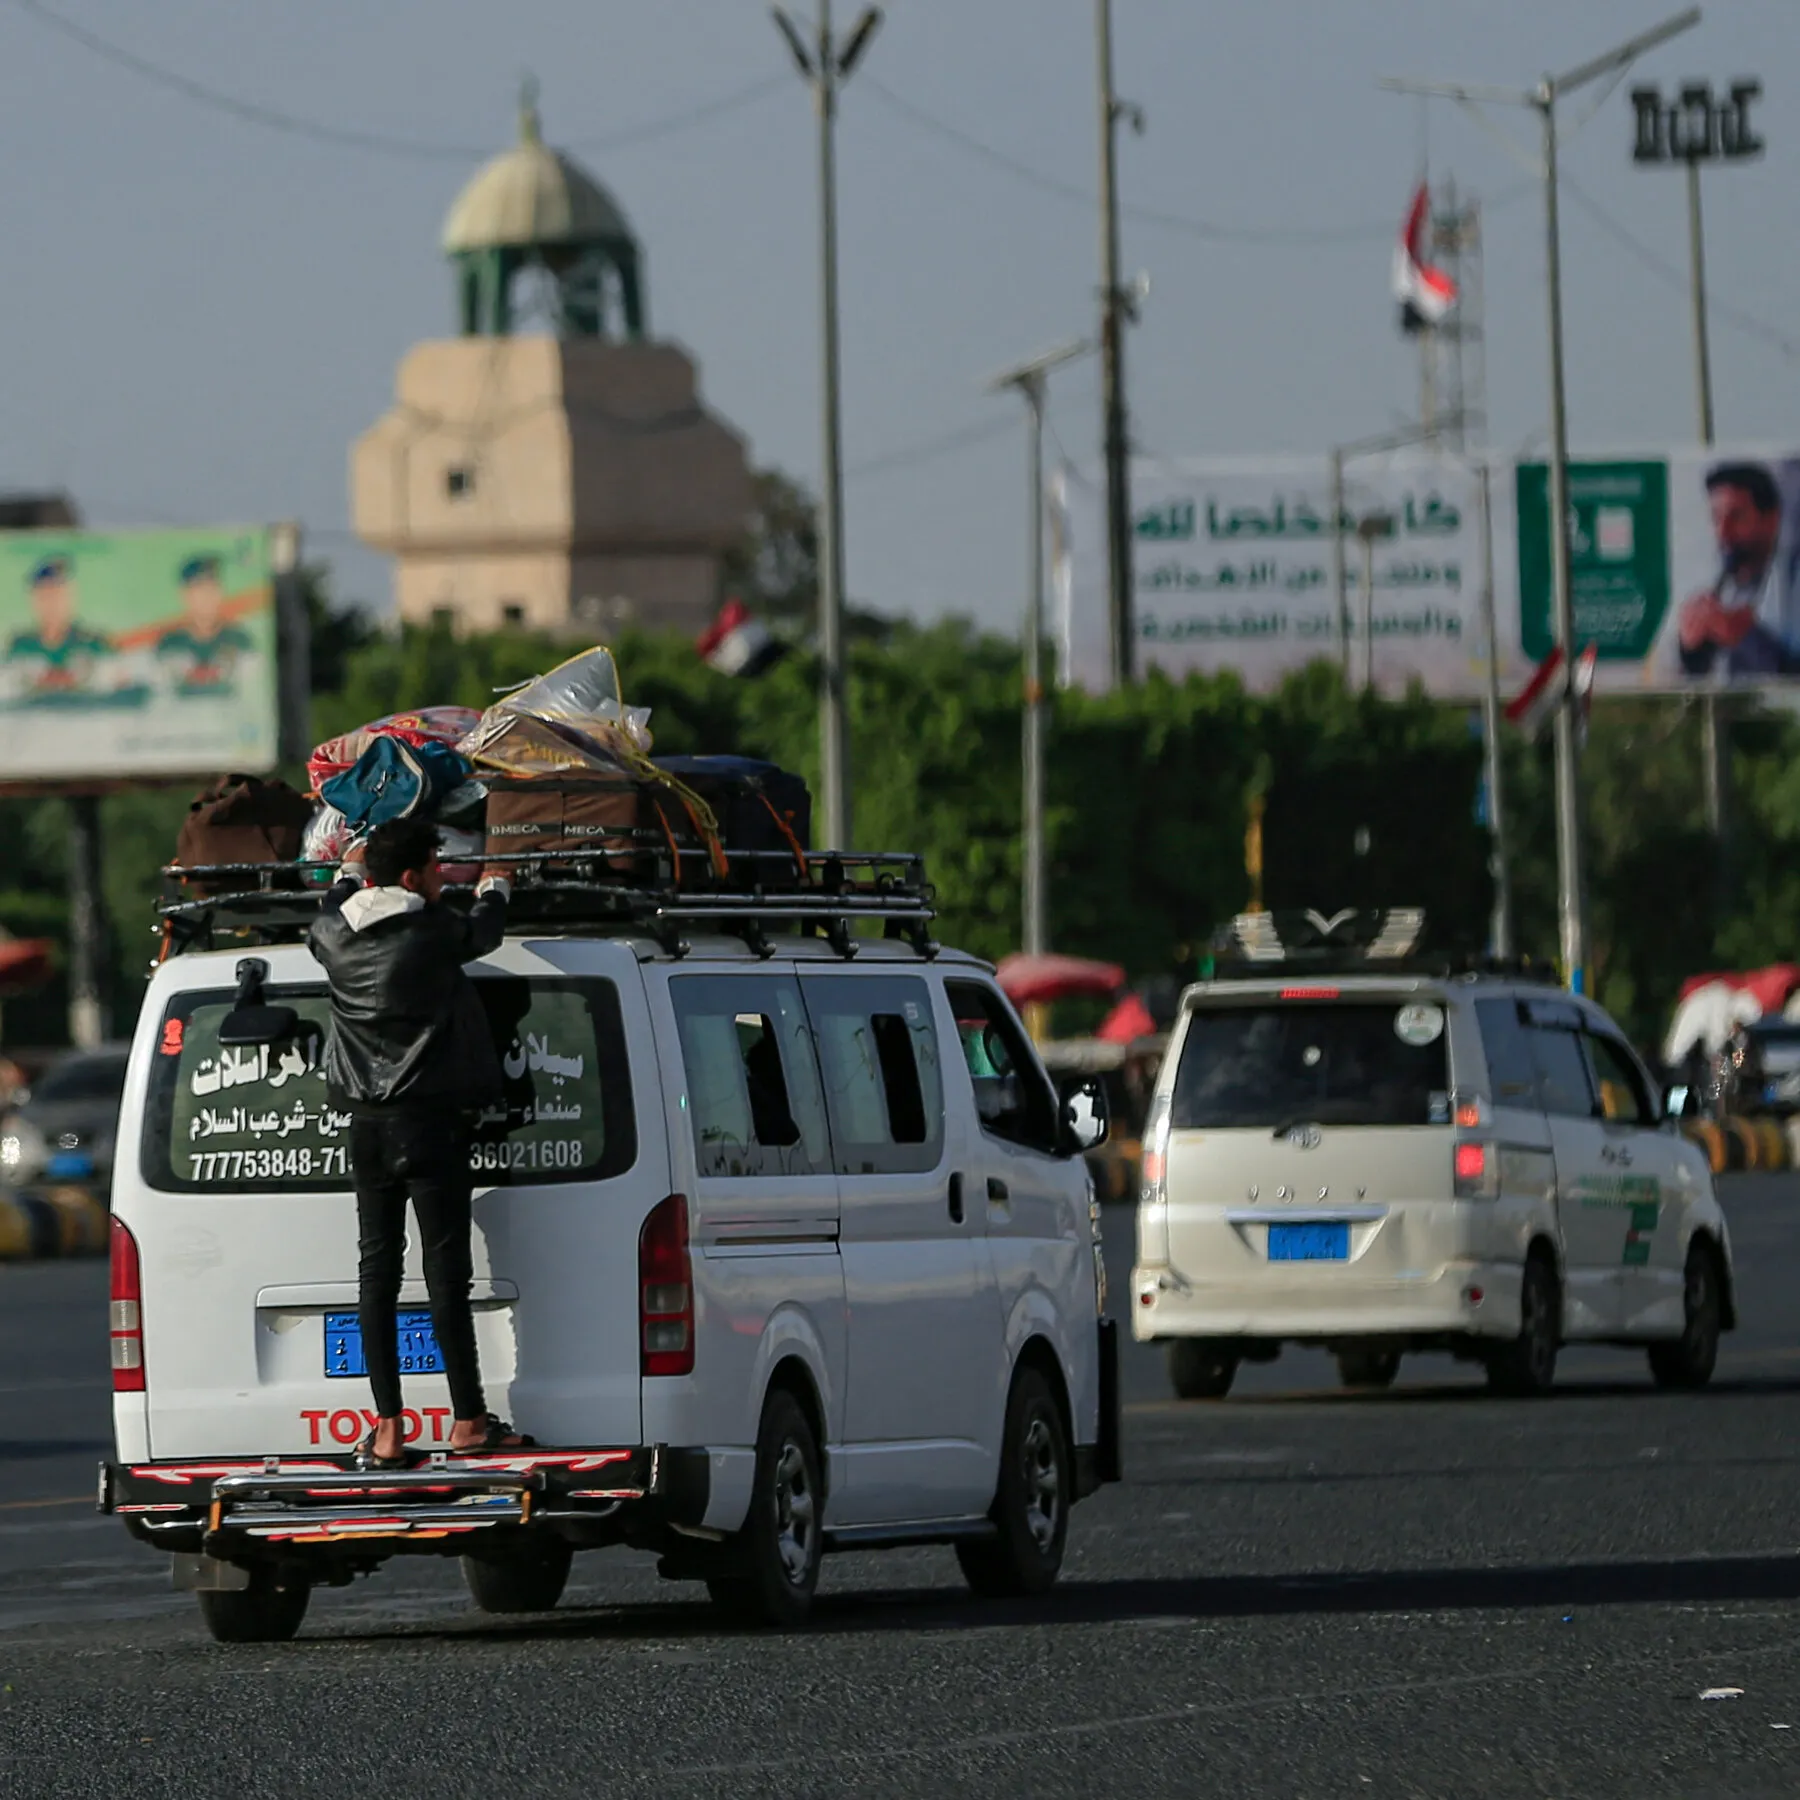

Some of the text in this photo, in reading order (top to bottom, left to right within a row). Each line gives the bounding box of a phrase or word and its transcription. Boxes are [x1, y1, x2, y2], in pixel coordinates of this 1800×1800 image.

[189, 1105, 247, 1141] السلام
[189, 1139, 584, 1181] 777753848-71 36021608
[300, 1407, 457, 1445] TOYOT
